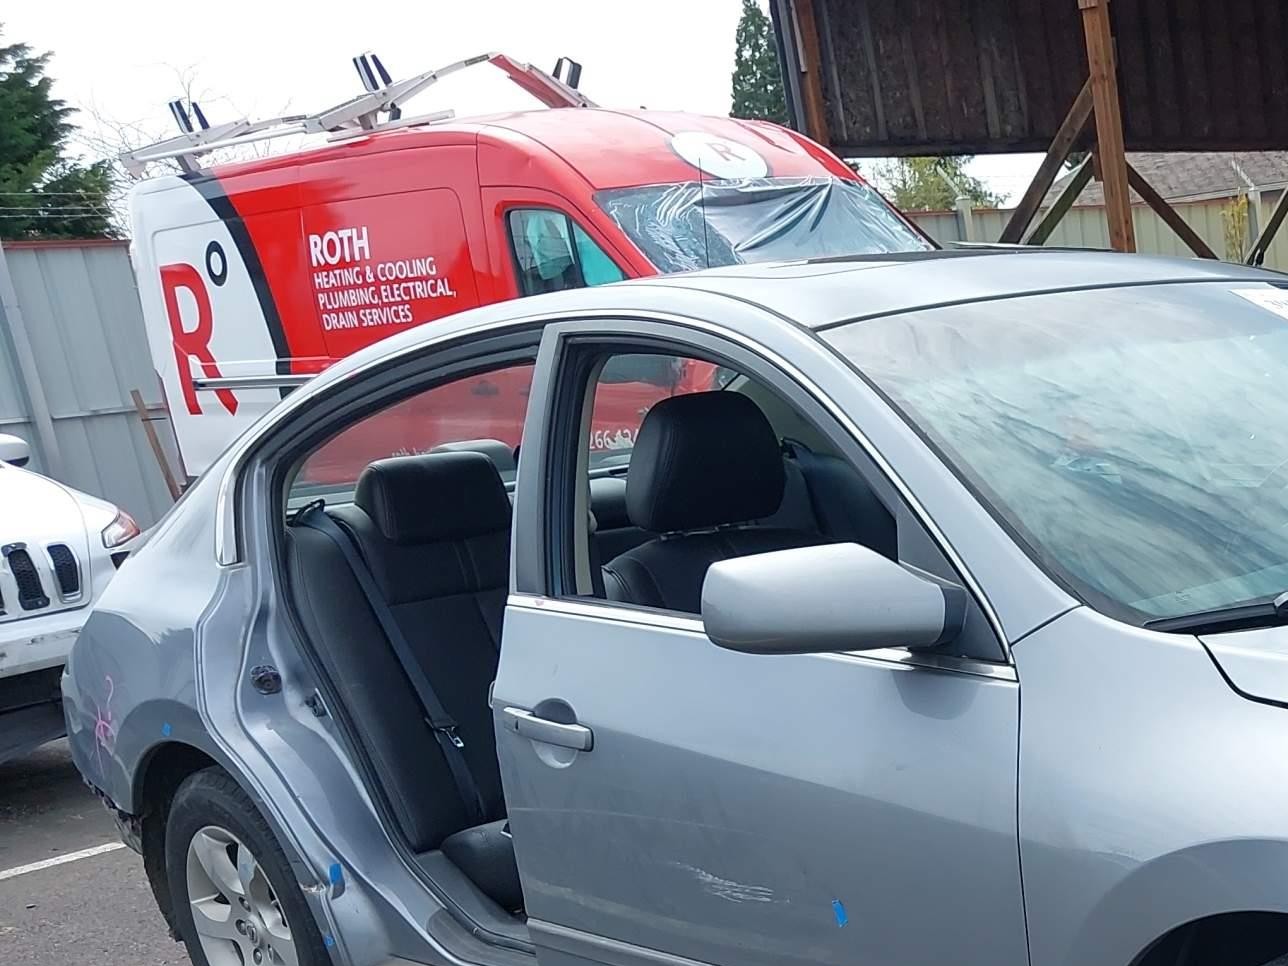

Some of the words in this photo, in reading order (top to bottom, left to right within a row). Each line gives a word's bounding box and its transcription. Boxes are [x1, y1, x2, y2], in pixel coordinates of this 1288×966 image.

[309, 226, 370, 267] ROTH
[314, 267, 363, 289] HEATING
[365, 265, 374, 283] &
[377, 256, 437, 282] COOLING
[317, 286, 382, 310] PLUMBING,
[380, 277, 457, 303] ELECTRICAL,
[322, 311, 359, 331] DRAIN
[360, 303, 413, 327] SERVICES
